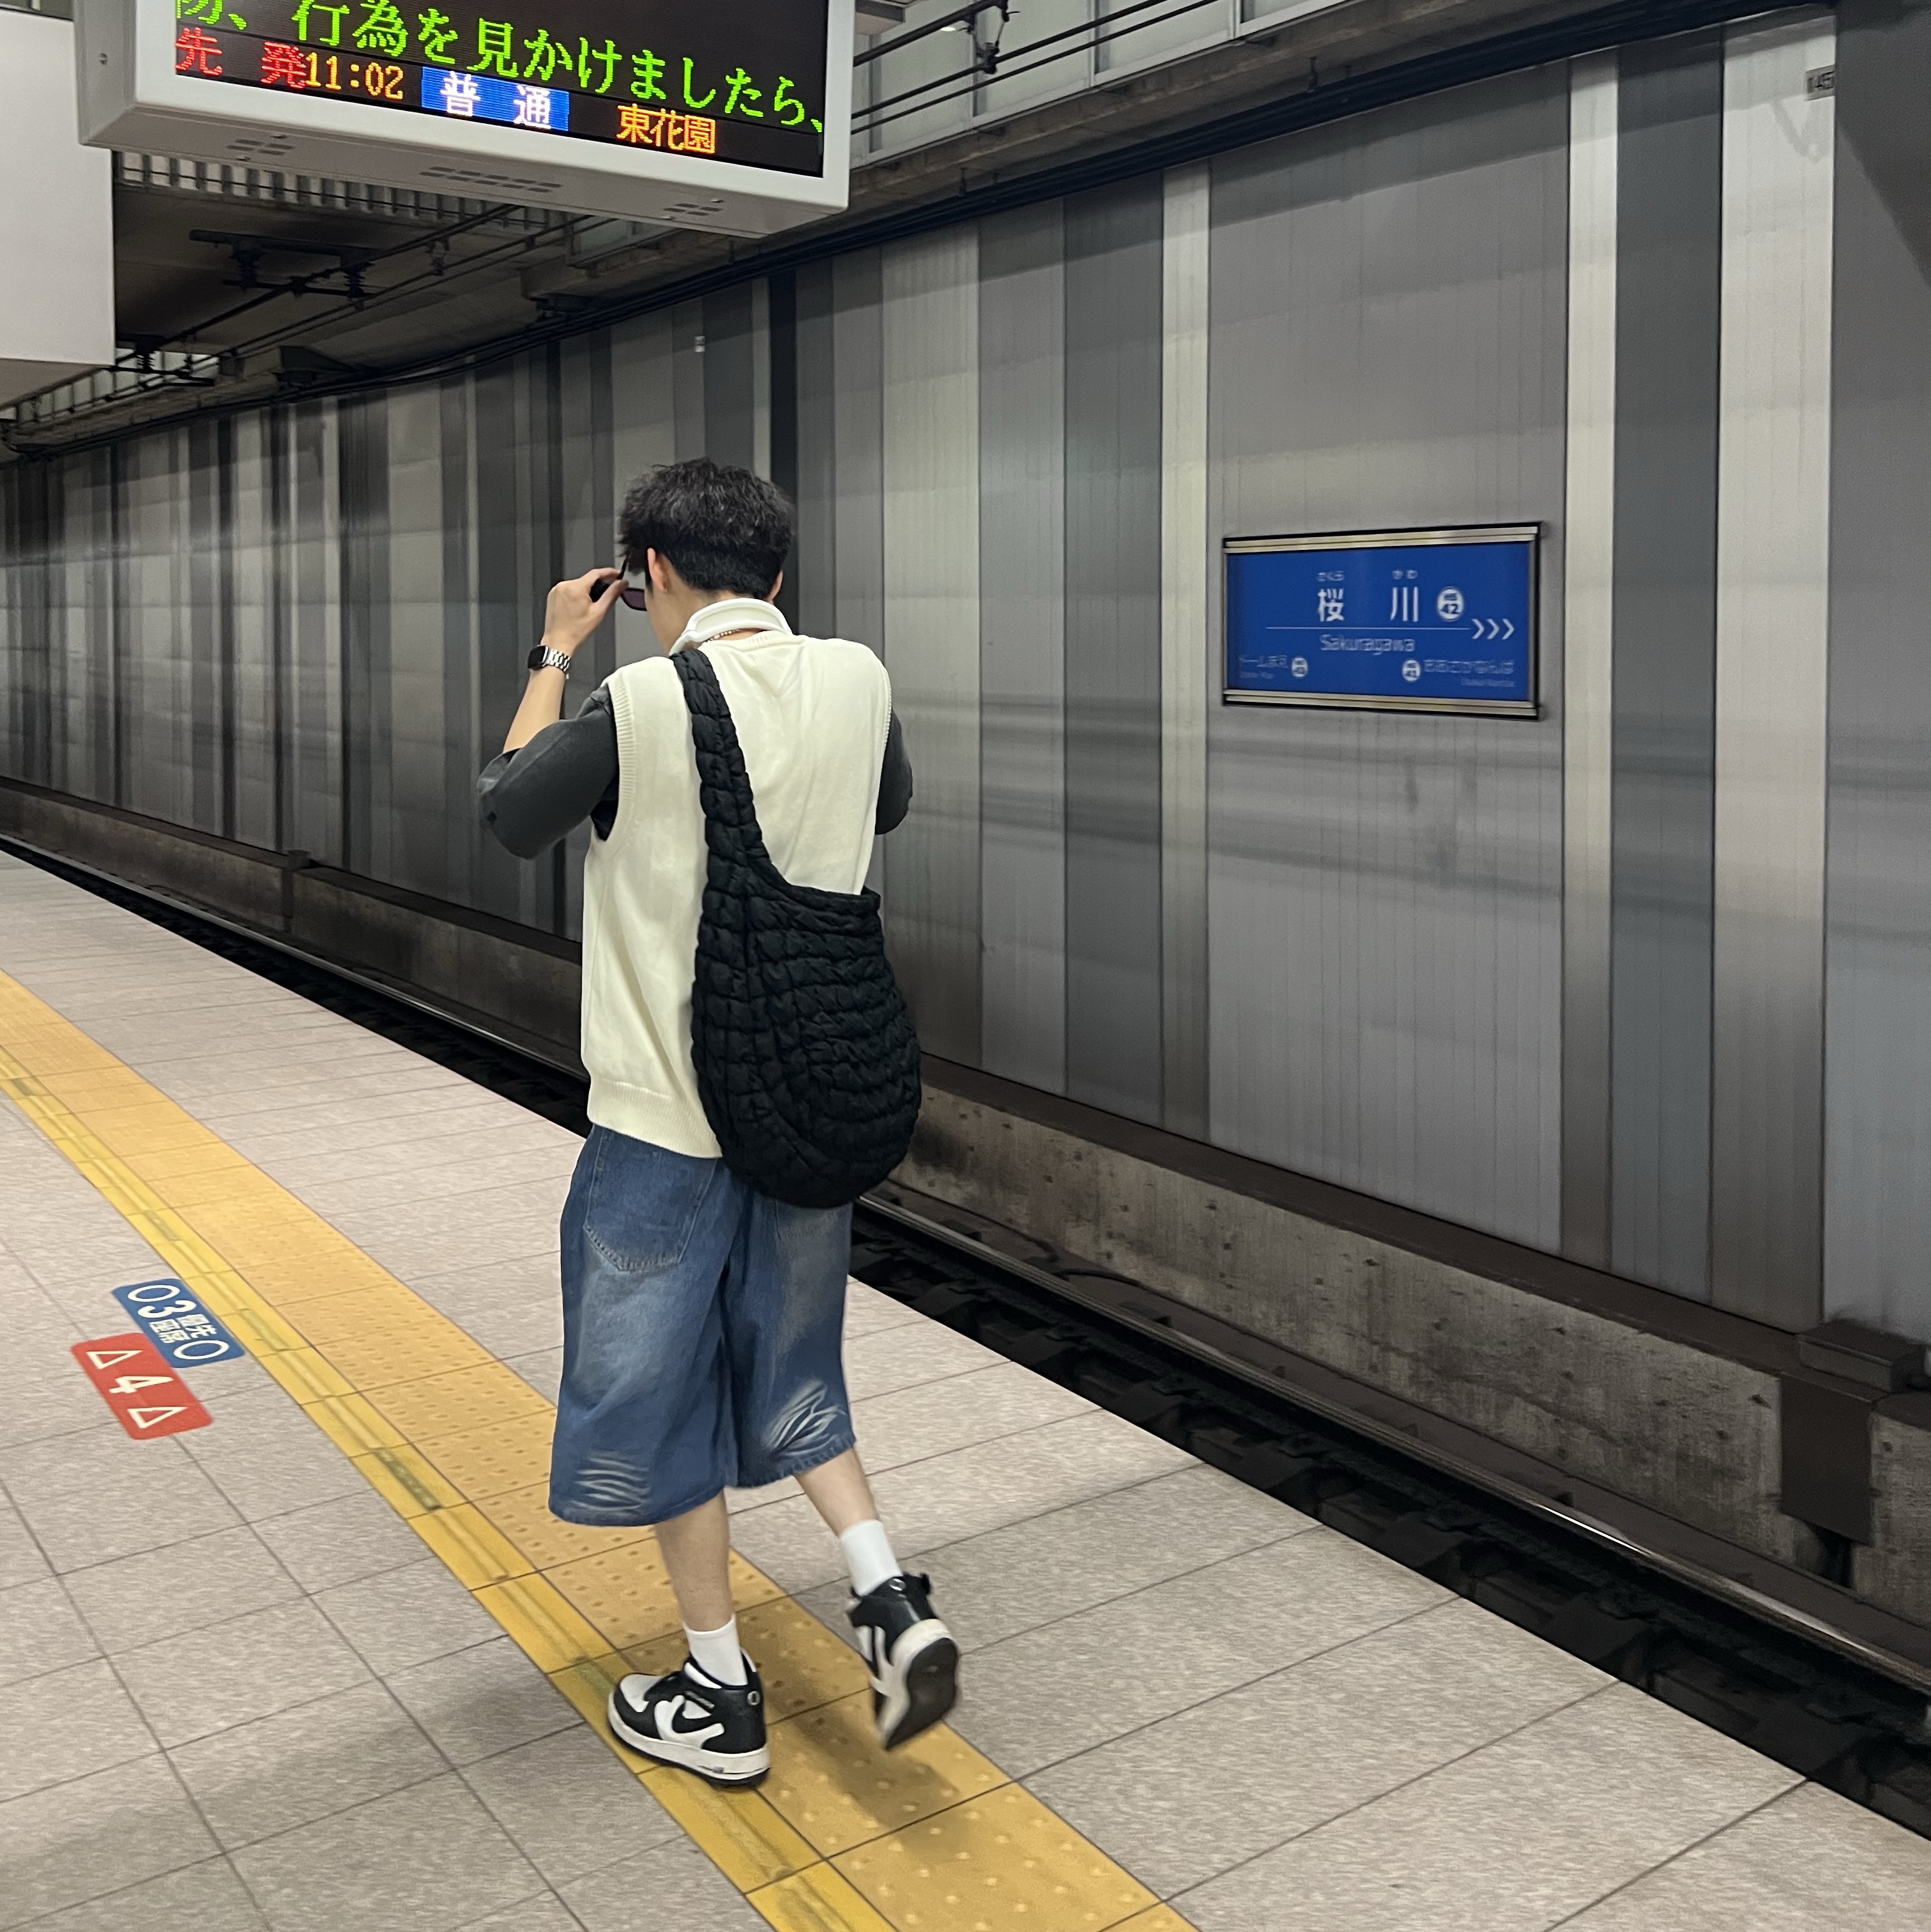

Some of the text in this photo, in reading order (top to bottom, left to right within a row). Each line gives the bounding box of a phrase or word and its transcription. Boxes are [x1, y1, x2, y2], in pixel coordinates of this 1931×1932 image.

[305, 52, 404, 100] 11:02
[616, 103, 717, 155] 東花園
[1440, 603, 1459, 614] 42
[1320, 634, 1416, 655] Sakuragawa
